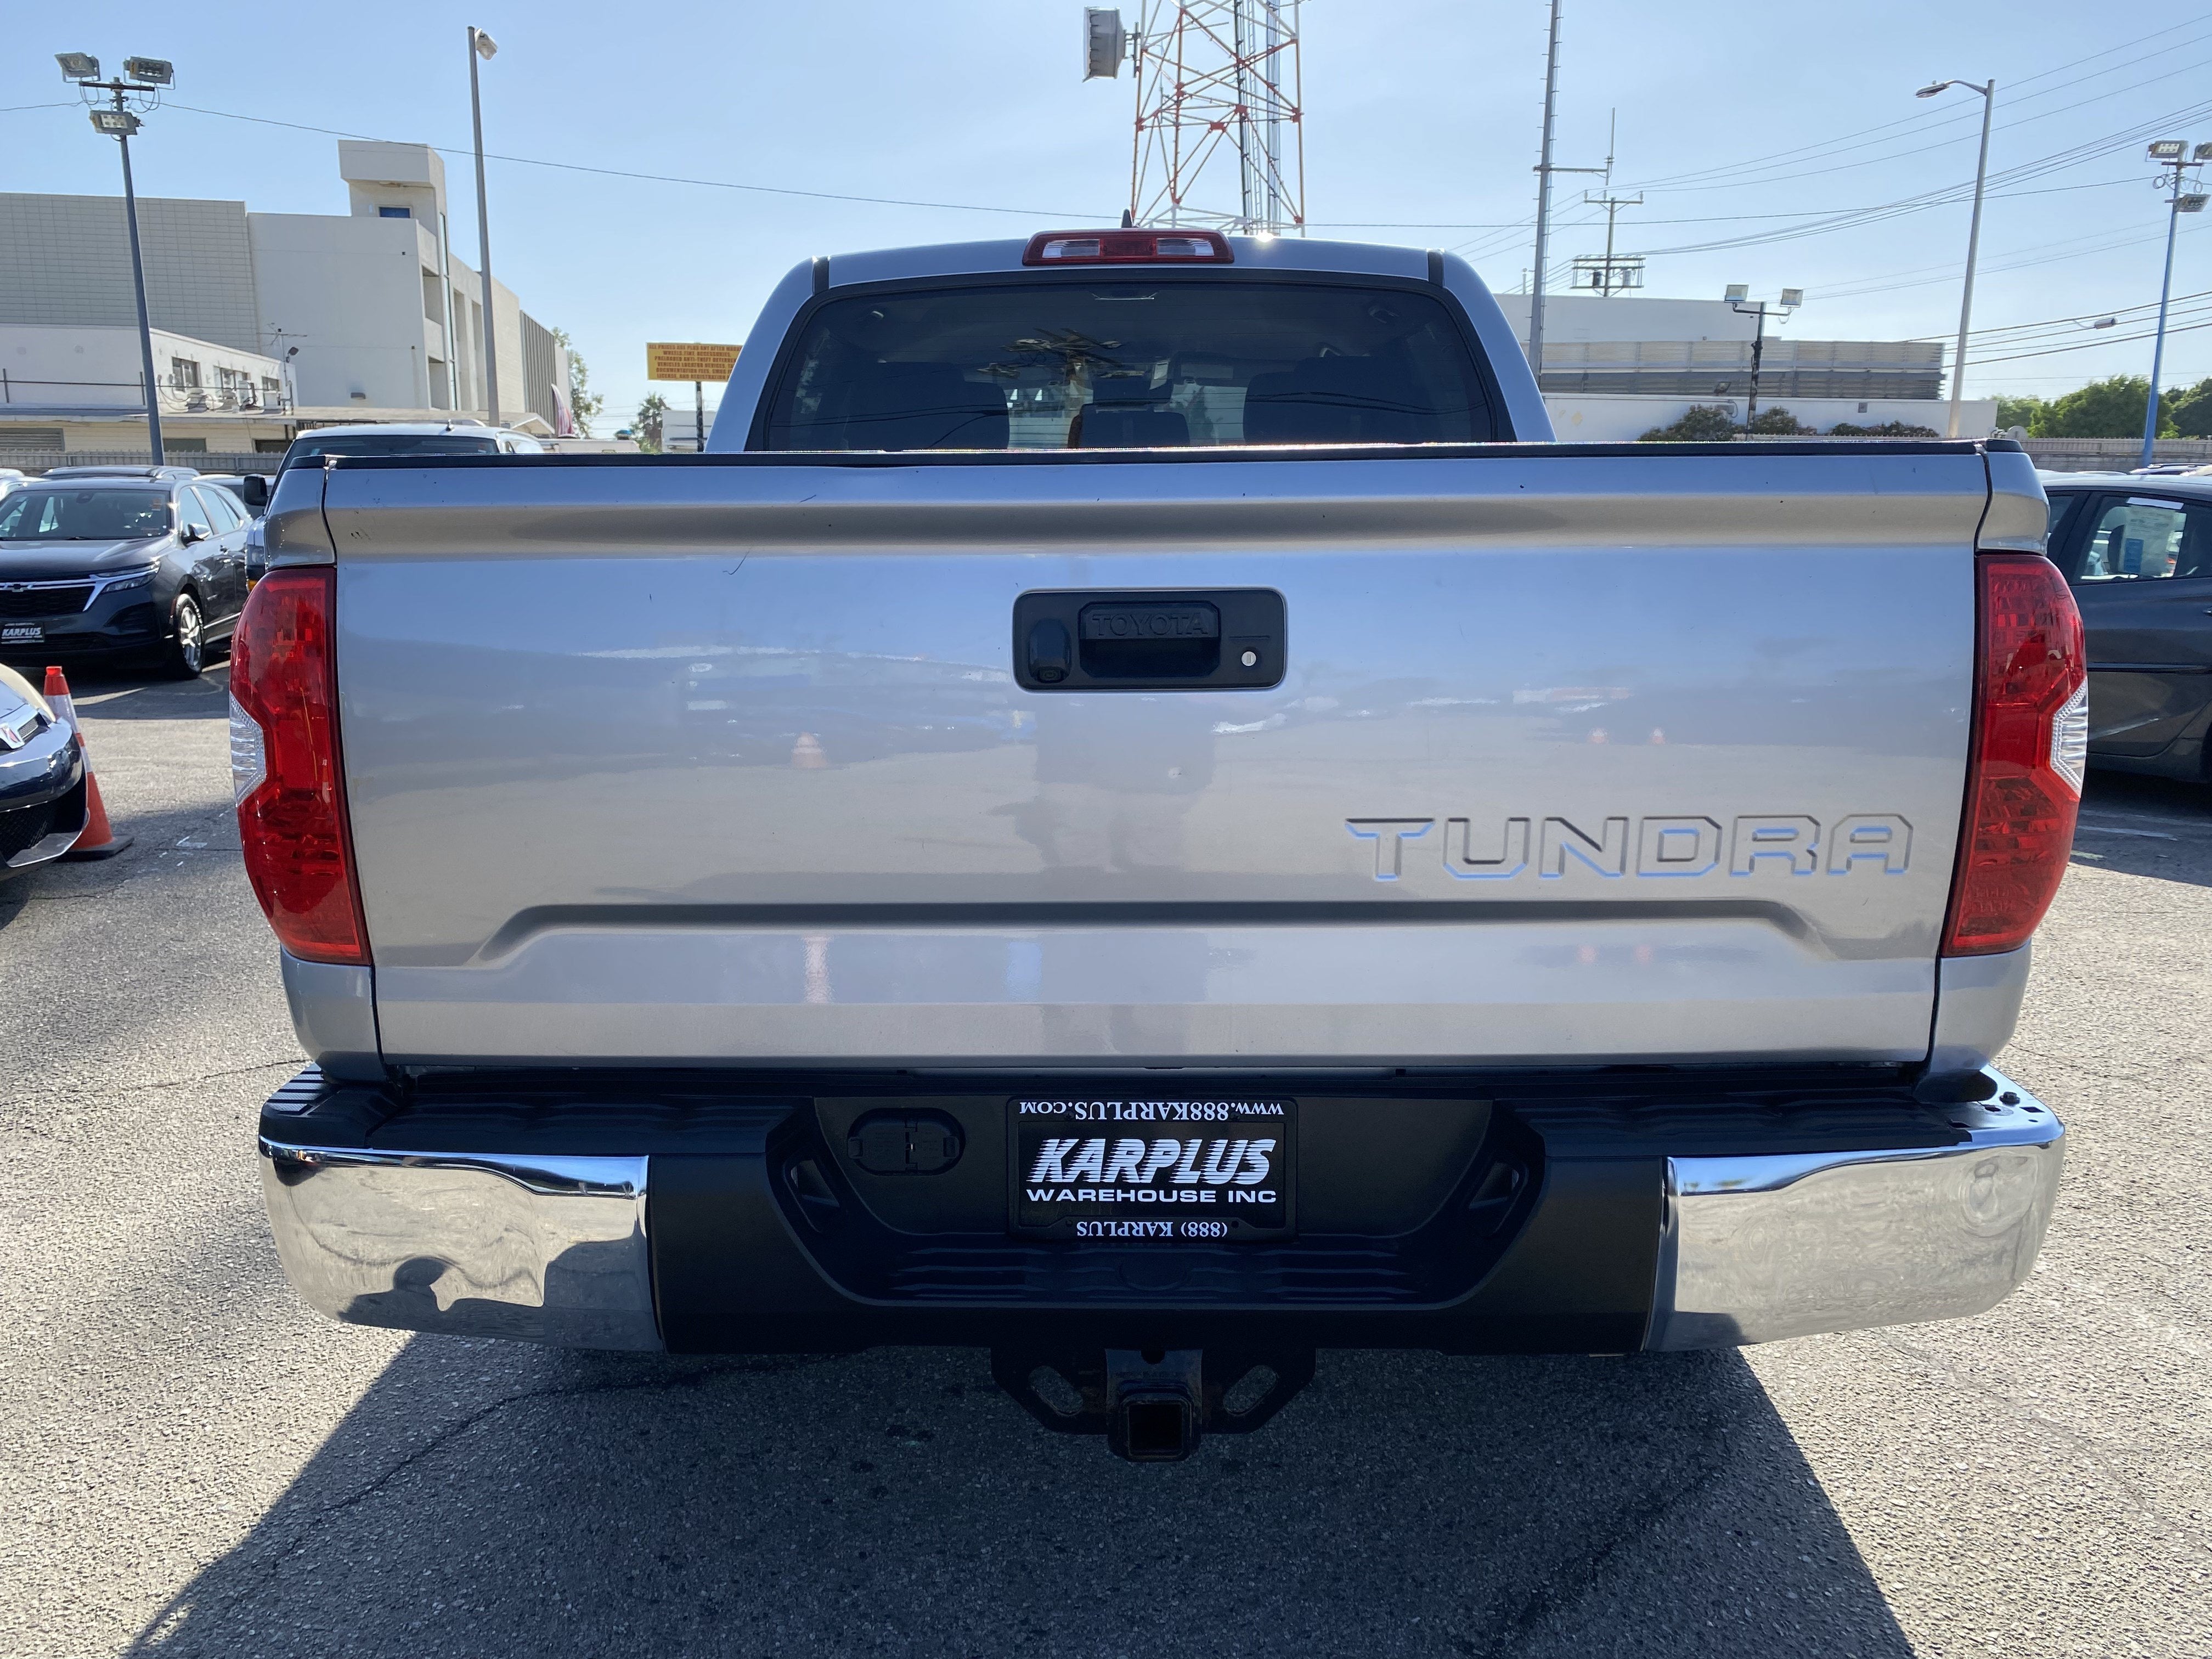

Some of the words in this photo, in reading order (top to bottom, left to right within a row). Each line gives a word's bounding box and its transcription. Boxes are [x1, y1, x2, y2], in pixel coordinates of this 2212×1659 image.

[2, 627, 42, 636] KARPLUS
[1092, 612, 1209, 636] TOYOTA
[1345, 814, 1914, 880] TUNDRA
[1026, 1138, 1277, 1185] KARPLUS
[1026, 1189, 1216, 1203] WAREHOUSE
[1228, 1190, 1276, 1203] INC
[1076, 1221, 1173, 1237] KARPLUS
[1181, 1221, 1228, 1238] (888)
